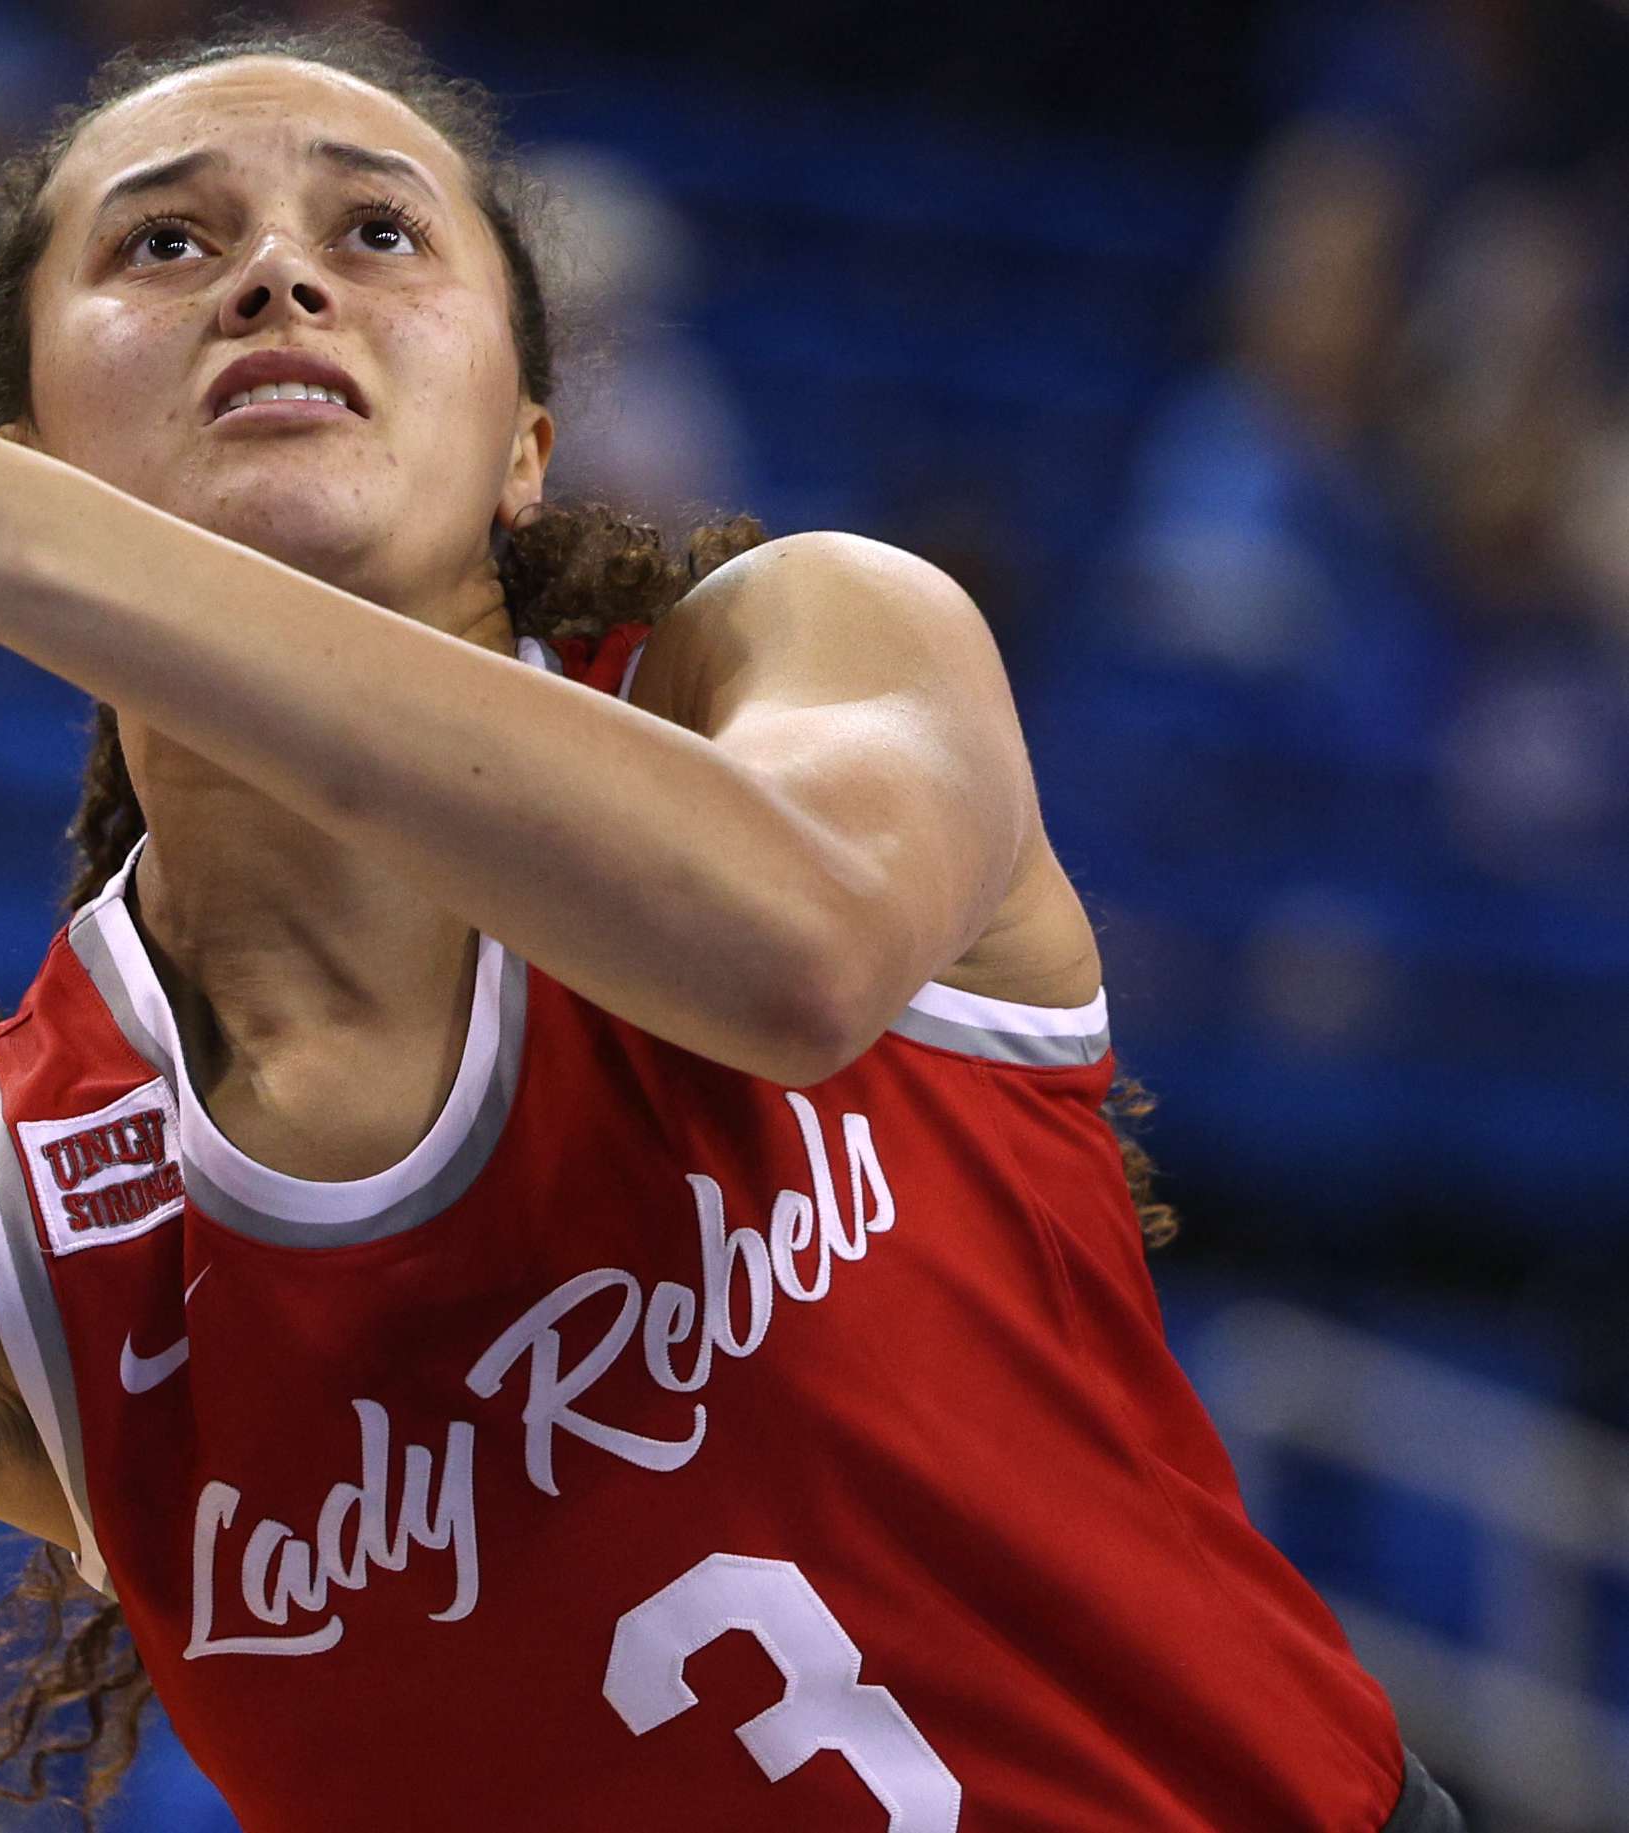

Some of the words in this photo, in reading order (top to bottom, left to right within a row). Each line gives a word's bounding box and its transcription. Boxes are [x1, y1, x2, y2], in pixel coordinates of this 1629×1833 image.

[41, 1107, 167, 1192] UNLV
[61, 1160, 186, 1233] STRONG
[183, 1399, 480, 1660] Lady
[464, 1091, 896, 1497] Rebels
[602, 1553, 962, 1833] 3
